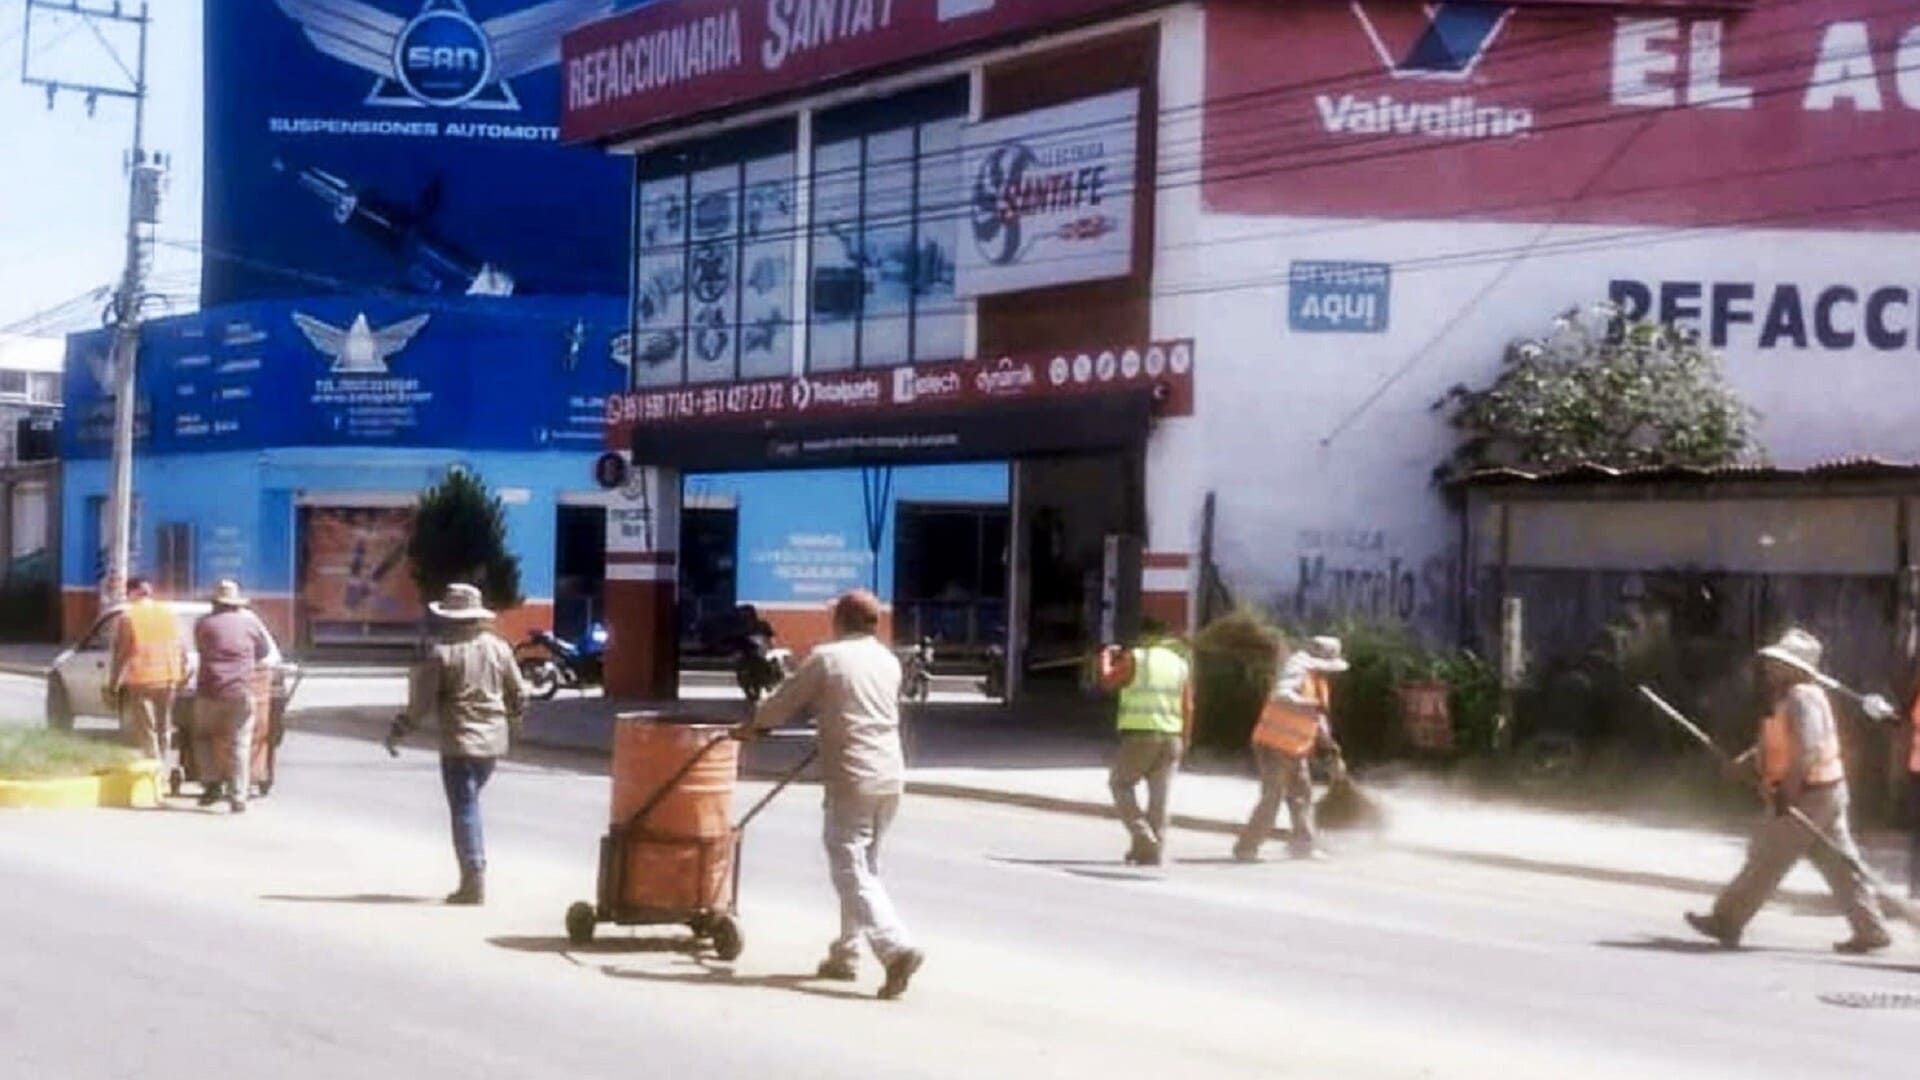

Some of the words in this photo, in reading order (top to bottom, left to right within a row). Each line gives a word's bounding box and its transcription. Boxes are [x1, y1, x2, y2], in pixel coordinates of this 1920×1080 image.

[408, 46, 479, 70] SAN
[569, 11, 743, 111] REFACCIONARIA
[1611, 17, 1752, 110] EL
[268, 117, 438, 137] SUSPENSIONES
[1315, 95, 1534, 138] Valvoline
[1603, 279, 1920, 351] REFACC
